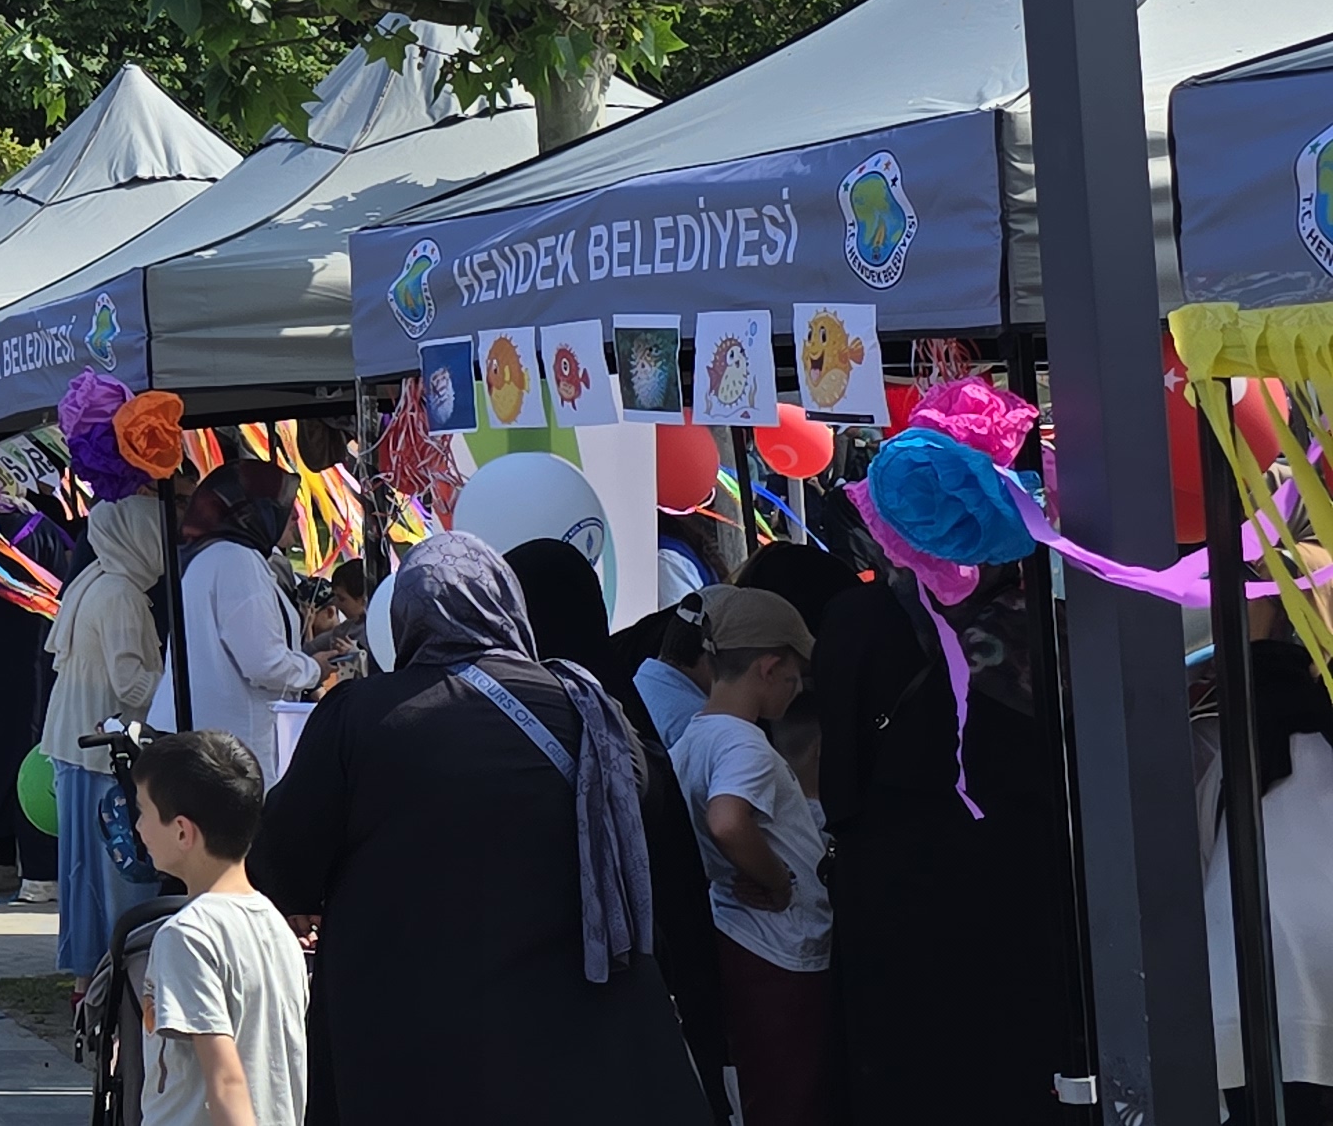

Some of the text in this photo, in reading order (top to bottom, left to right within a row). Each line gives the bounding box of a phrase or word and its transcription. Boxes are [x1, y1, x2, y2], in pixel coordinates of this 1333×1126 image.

[452, 186, 799, 307] HENDEK BELEDİYESİ
[847, 245, 883, 285] HENDEK
[2, 314, 77, 378] BELEDİYESİ
[514, 708, 537, 728] OF
